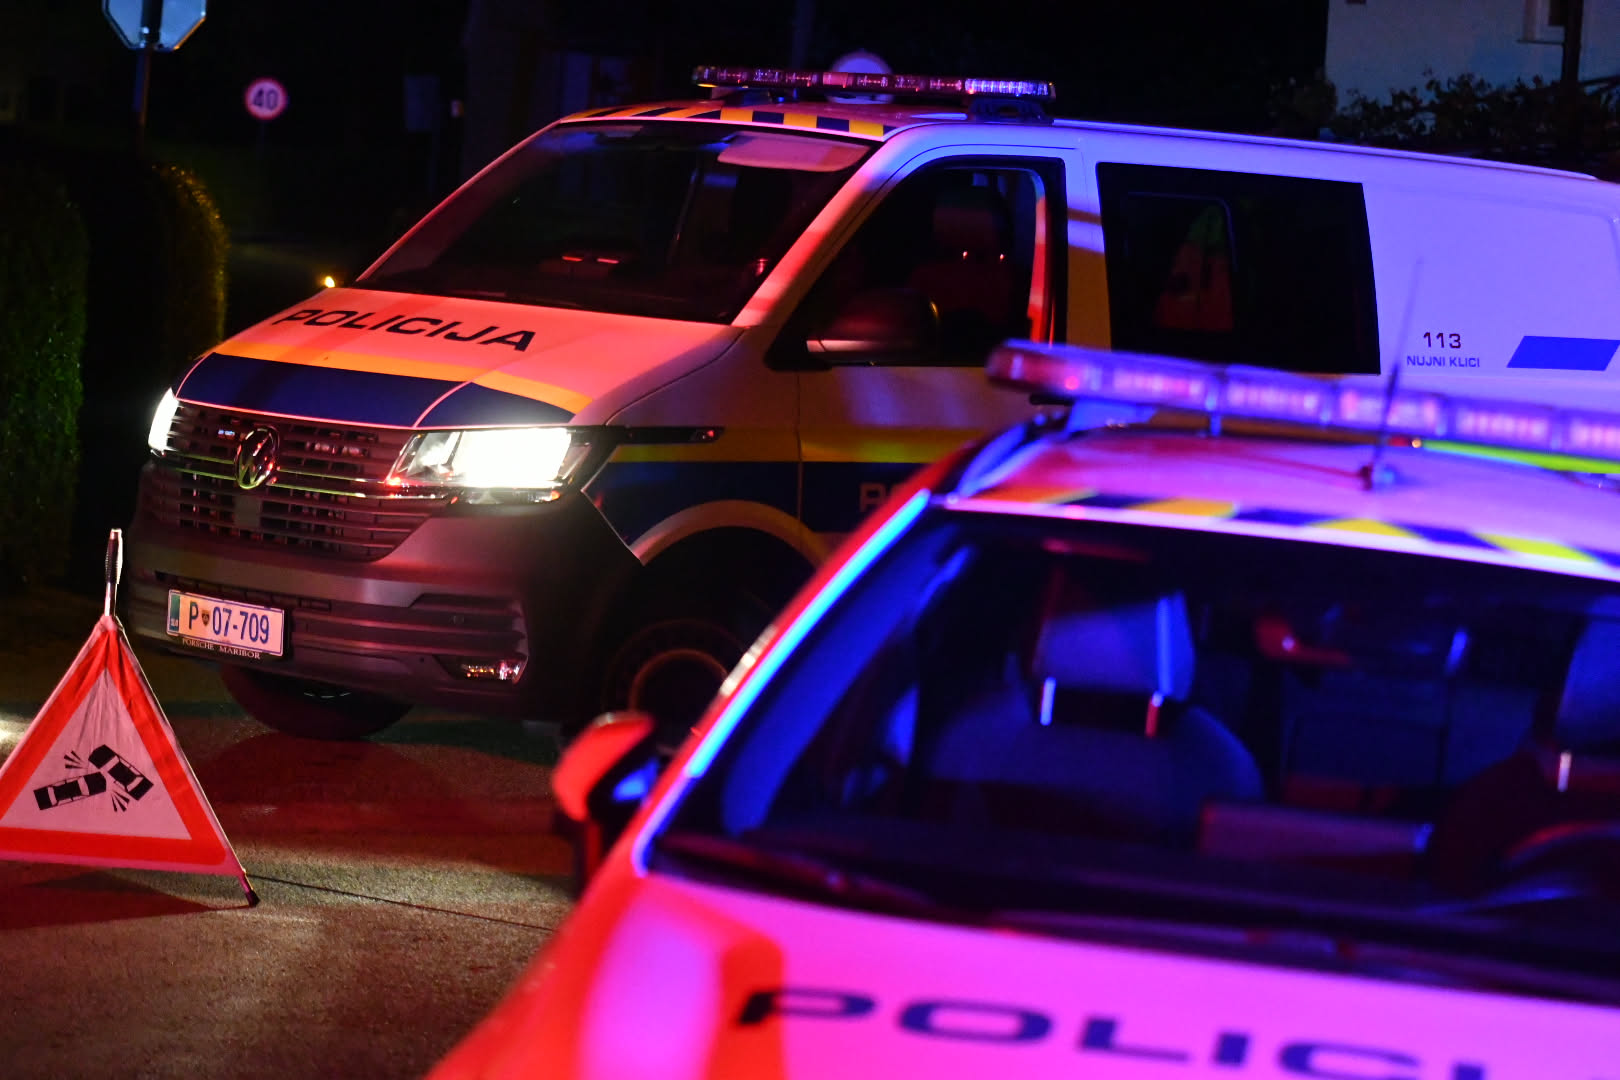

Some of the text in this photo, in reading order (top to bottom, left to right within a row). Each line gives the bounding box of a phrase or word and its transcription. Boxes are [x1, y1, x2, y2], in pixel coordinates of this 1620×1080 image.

[253, 88, 279, 110] 40
[271, 309, 537, 352] POLICIJA
[1423, 331, 1462, 349] 113
[1406, 355, 1481, 368] NUJNI KLICI
[188, 601, 270, 644] P 07-709
[182, 638, 261, 660] PORSCHE MARIBOR
[735, 987, 1487, 1080] POLICI
